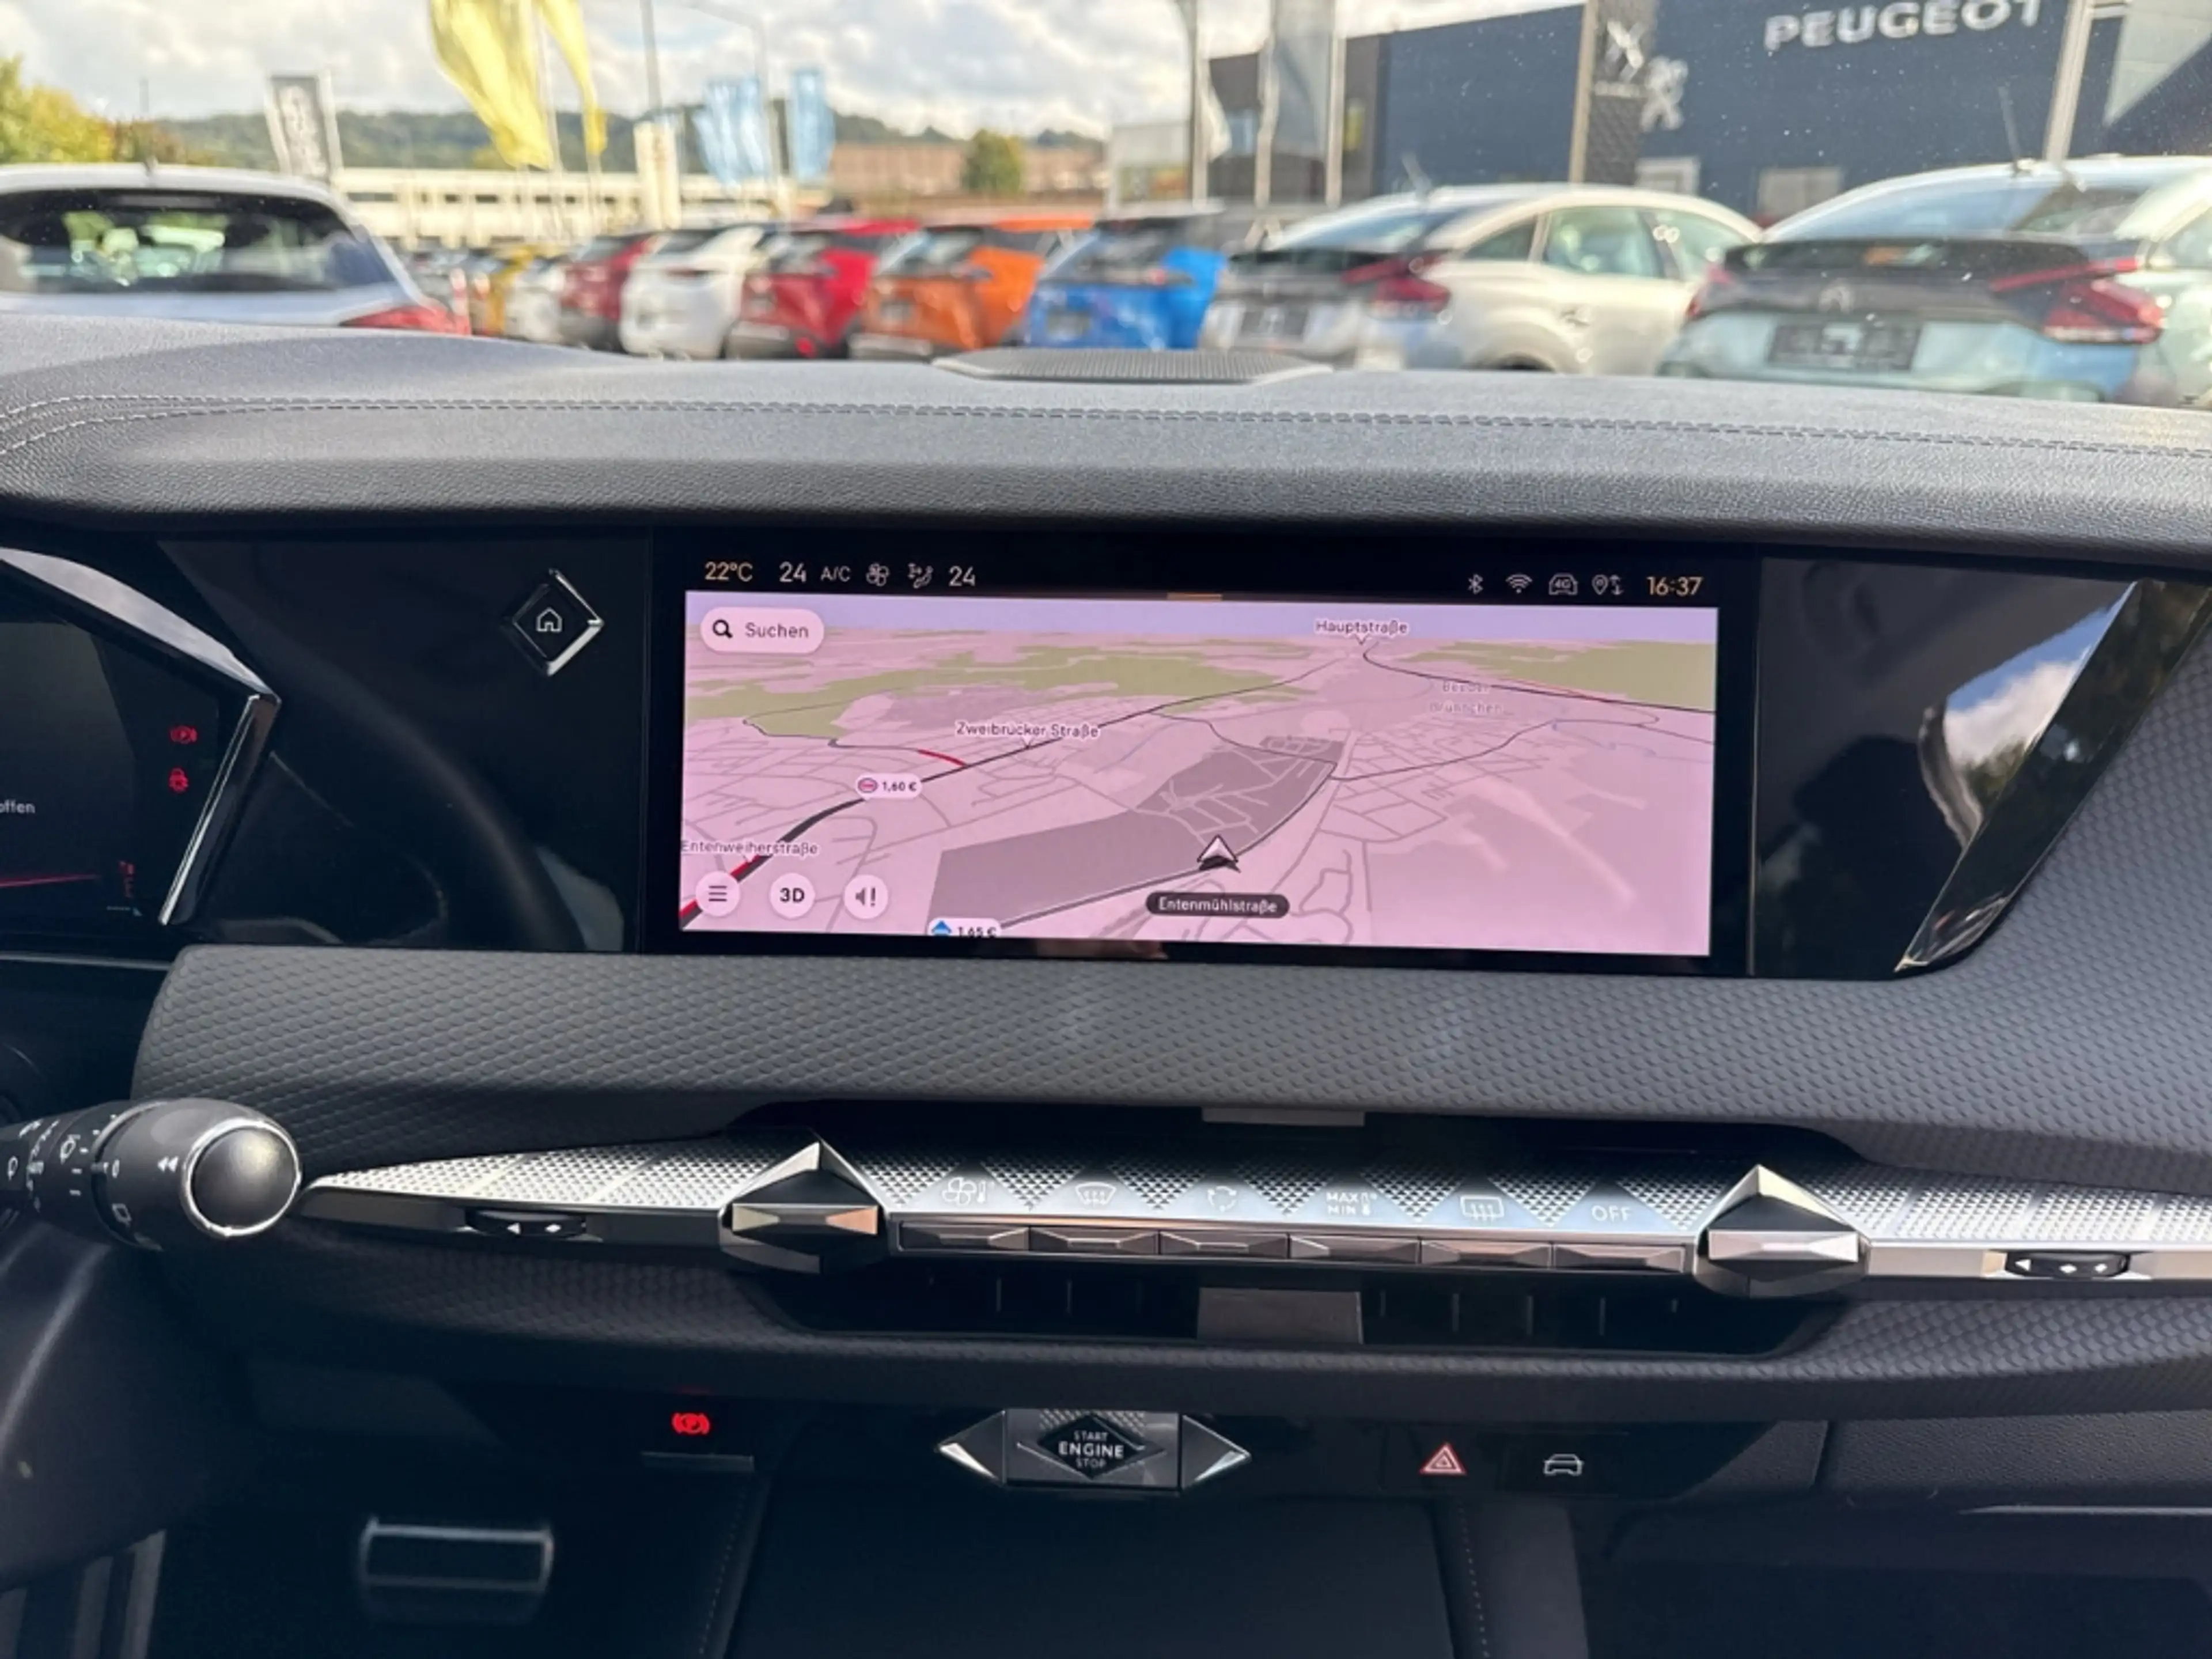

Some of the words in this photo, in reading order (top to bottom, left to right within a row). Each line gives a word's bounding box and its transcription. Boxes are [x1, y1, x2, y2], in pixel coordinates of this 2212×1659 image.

[779, 561, 807, 583] 24
[820, 566, 852, 582] A/C
[948, 566, 976, 586] 24
[1647, 575, 1703, 596] 16:37
[744, 622, 809, 638] Suchen
[1315, 619, 1408, 636] Hauptstraße
[1051, 723, 1099, 738] Straße
[681, 840, 818, 856] Entenweiherstraße
[779, 887, 805, 903] 3D
[1158, 896, 1278, 915] Entenmühlstraße
[1325, 1191, 1359, 1204] MAX
[1327, 1204, 1357, 1216] MIN
[1591, 1205, 1631, 1222] OFF
[1073, 1430, 1109, 1442] START
[1058, 1441, 1124, 1460] ENGINE
[1075, 1457, 1107, 1469] STOP
